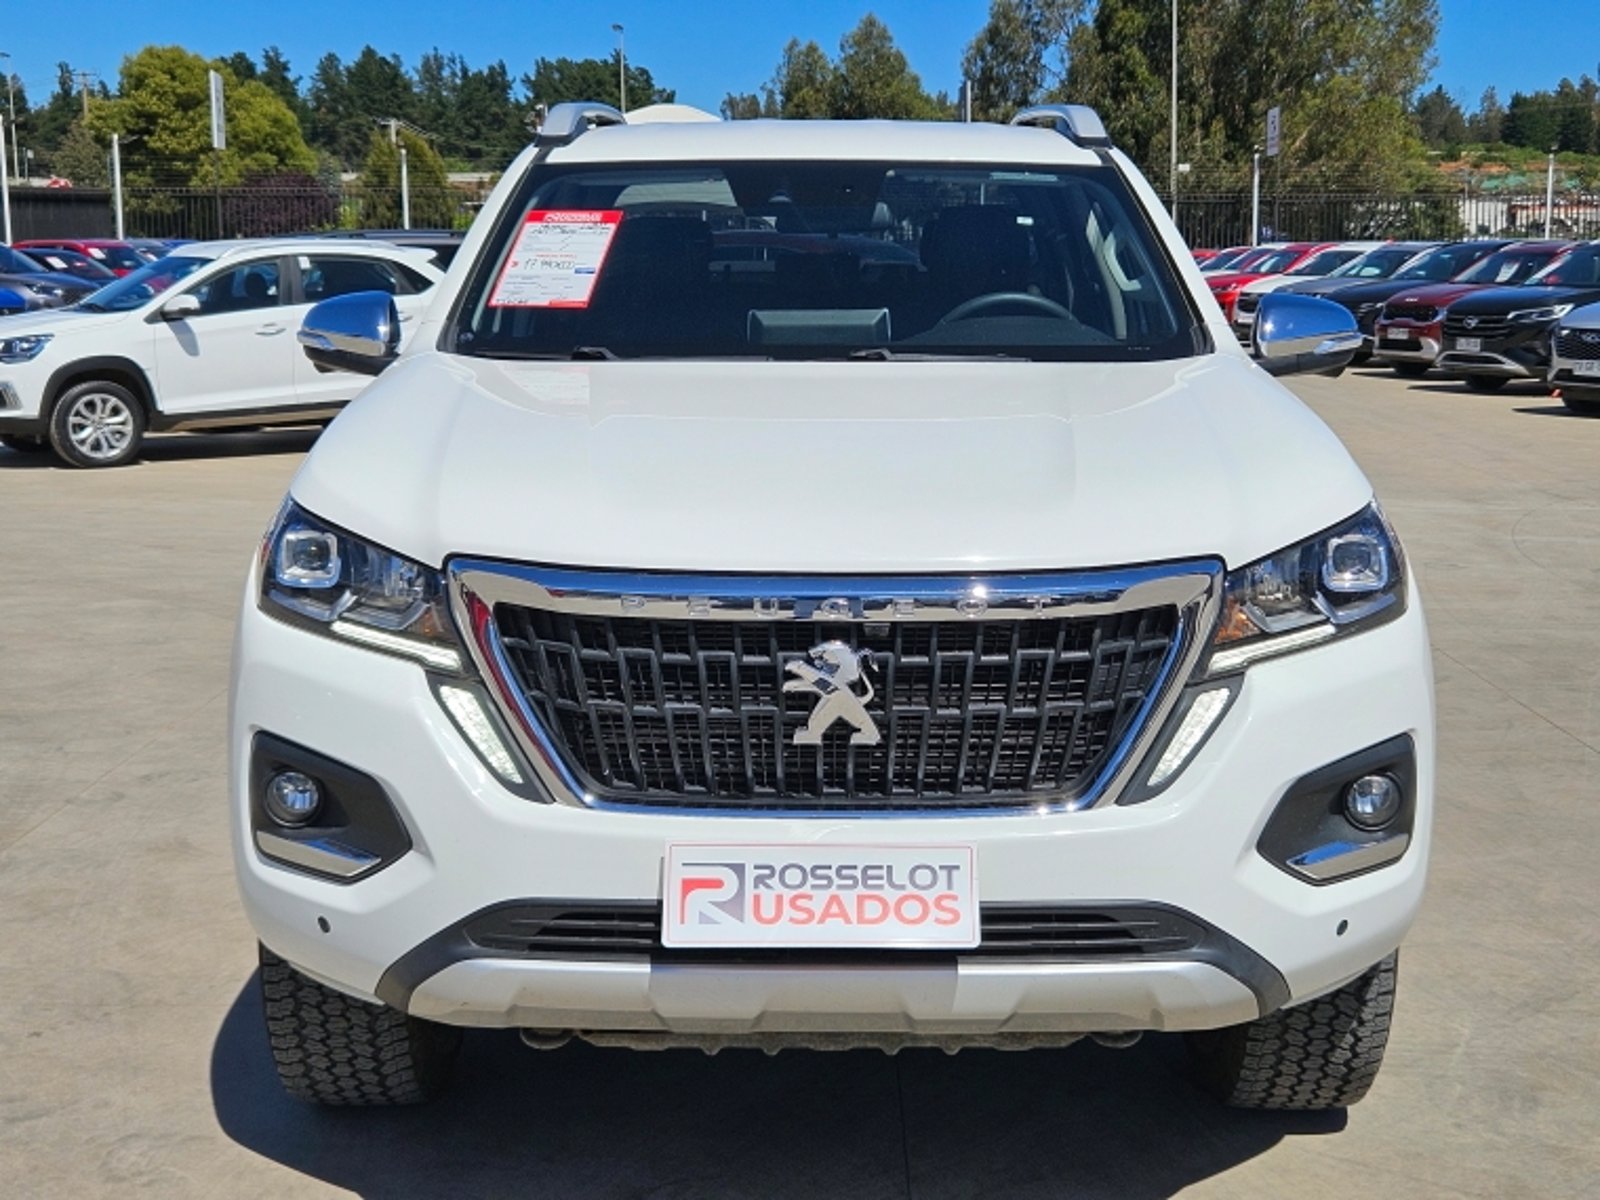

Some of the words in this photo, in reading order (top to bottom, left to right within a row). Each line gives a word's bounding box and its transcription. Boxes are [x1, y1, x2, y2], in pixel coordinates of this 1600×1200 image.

[620, 596, 1052, 619] PEUGEOT
[752, 863, 961, 891] ROSSELOT
[752, 893, 962, 926] USADOS
